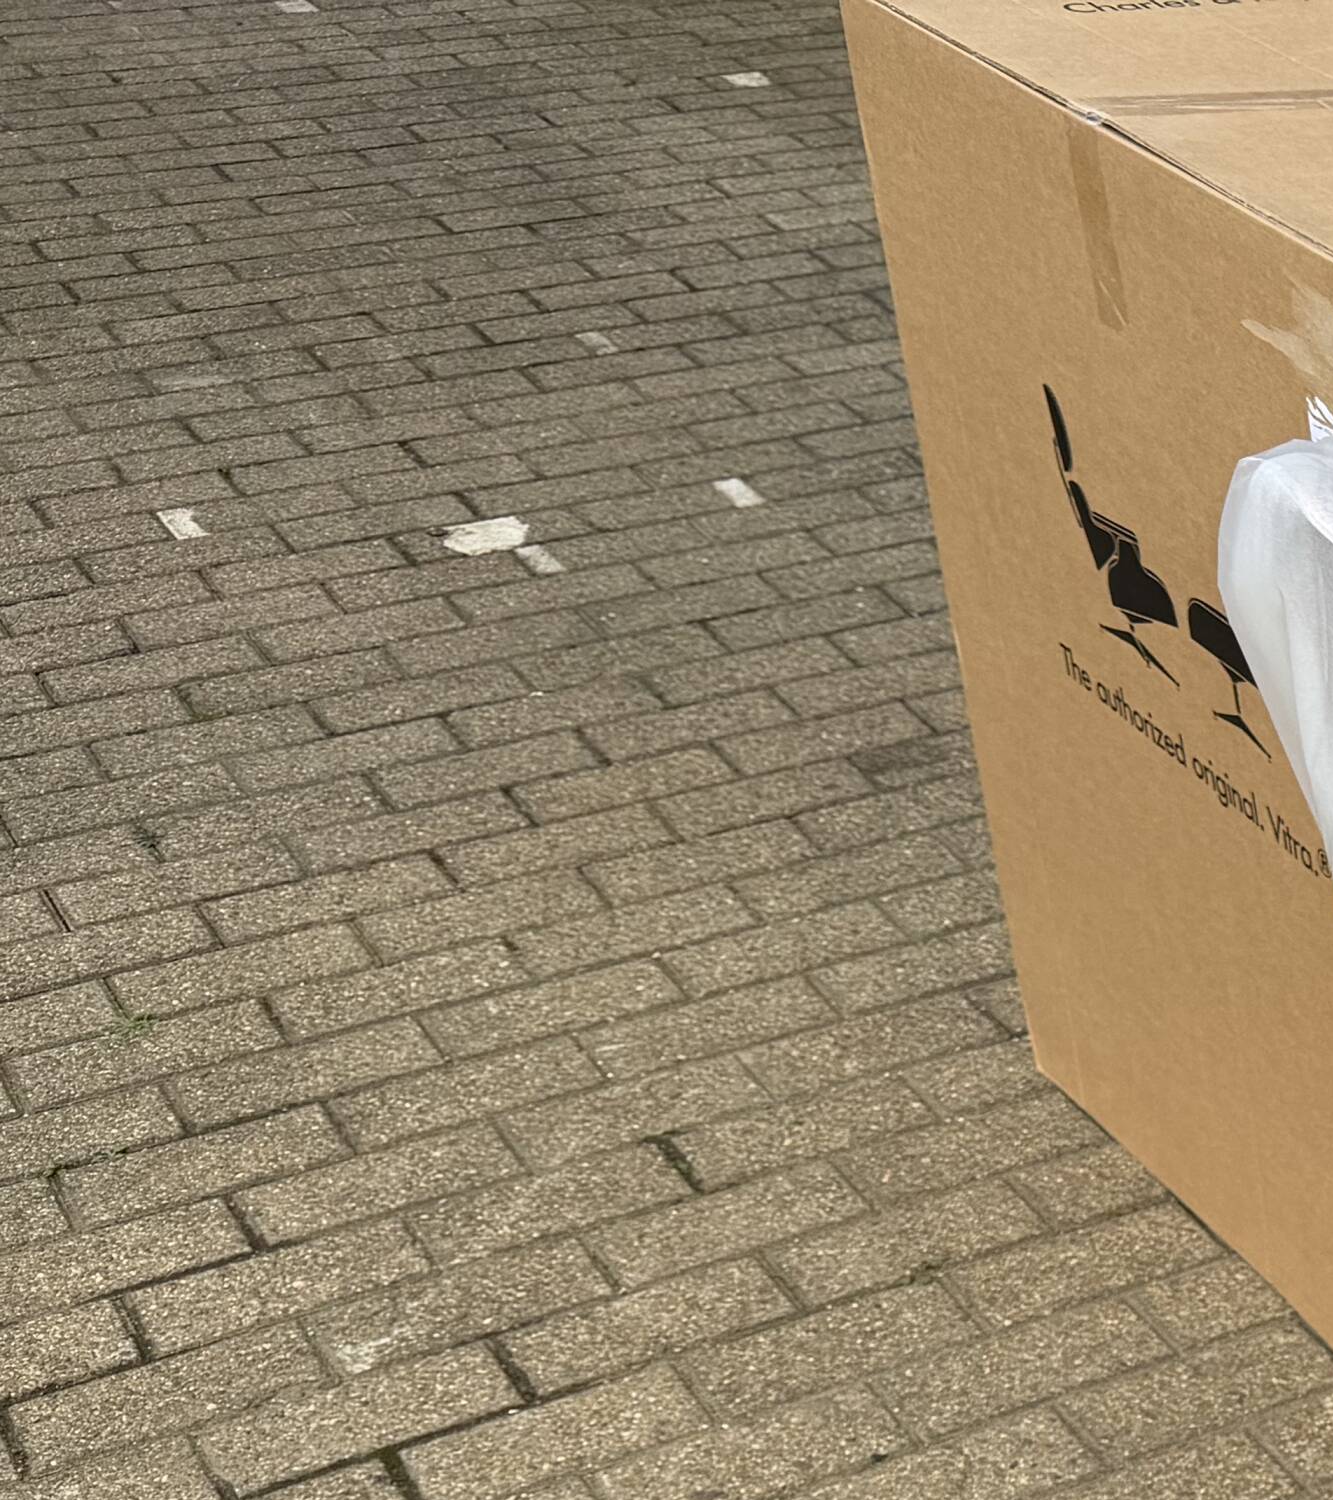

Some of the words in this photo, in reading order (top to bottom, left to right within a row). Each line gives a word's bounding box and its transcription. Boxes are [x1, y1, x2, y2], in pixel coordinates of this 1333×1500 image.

[1060, 643, 1091, 691] The
[1097, 682, 1186, 767] authorized
[1193, 758, 1264, 831] original.
